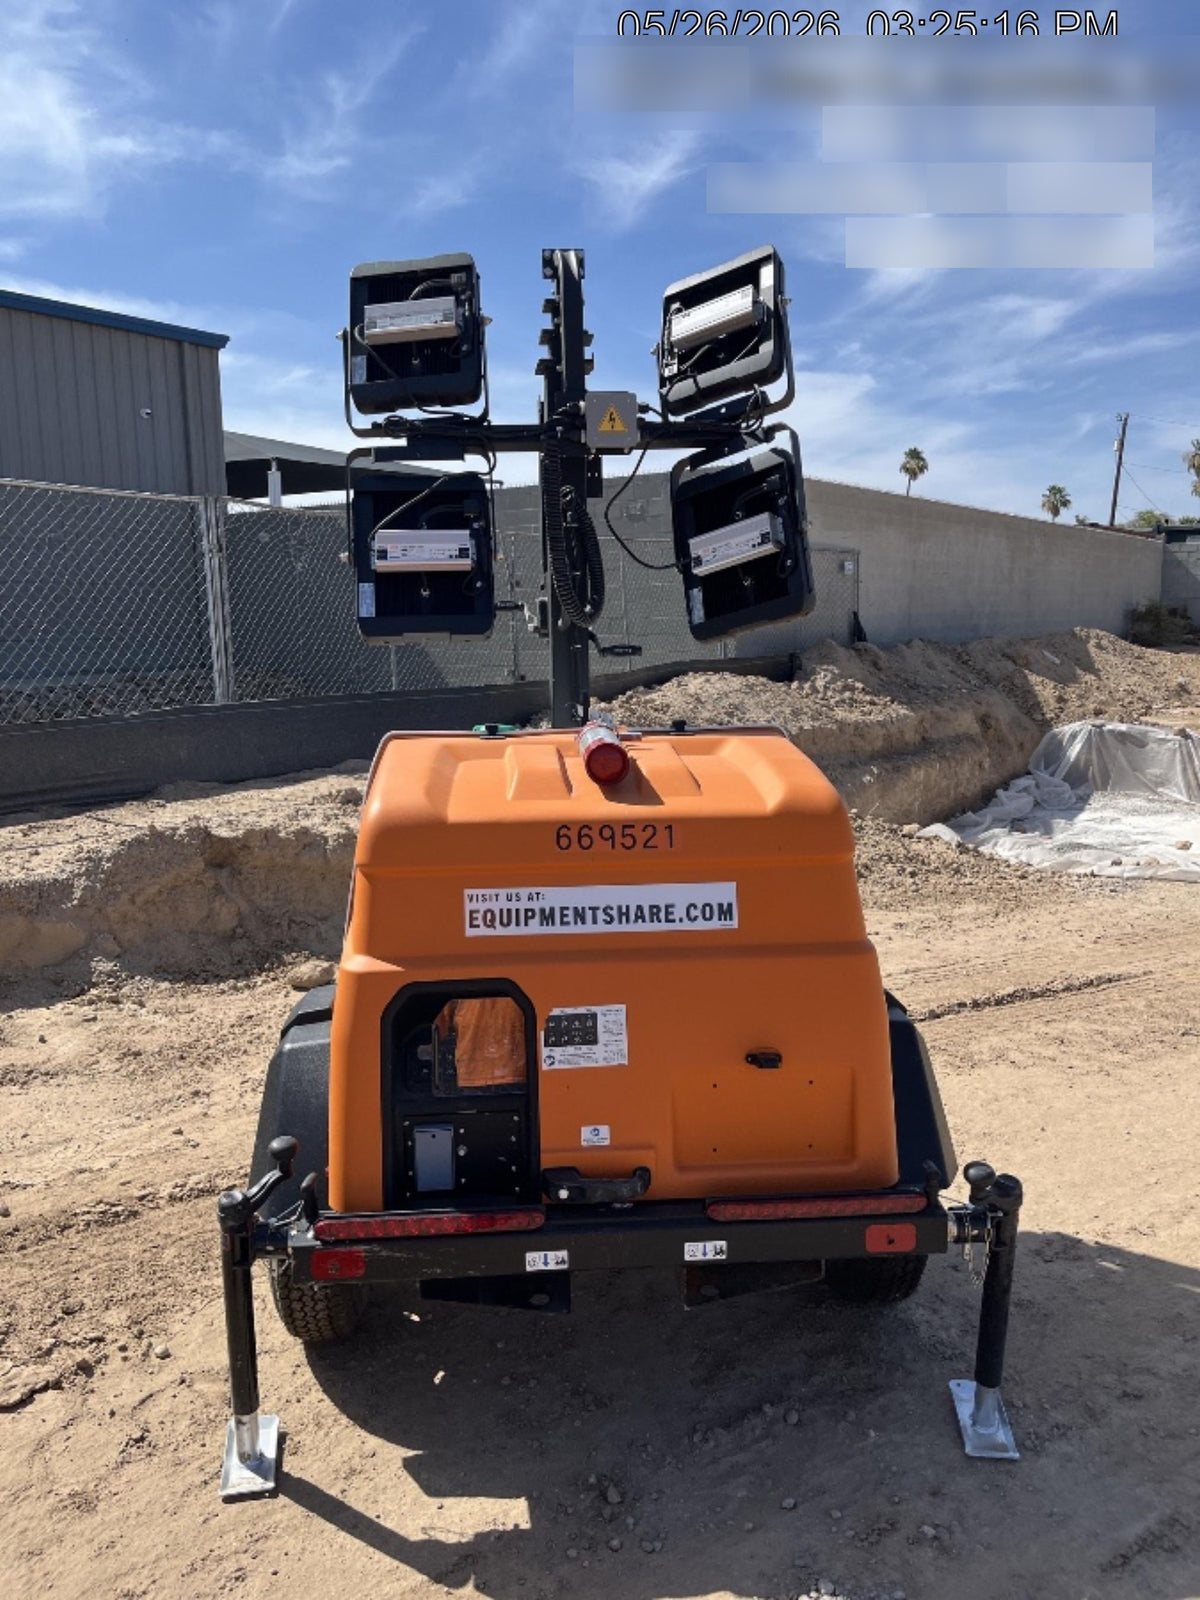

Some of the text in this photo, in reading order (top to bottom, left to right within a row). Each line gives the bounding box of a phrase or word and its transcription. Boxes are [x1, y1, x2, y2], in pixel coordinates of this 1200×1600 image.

[556, 824, 674, 850] 669521
[467, 892, 545, 903] VISIT US AT:
[468, 902, 734, 930] EQUIPMENTSHARE.COM
